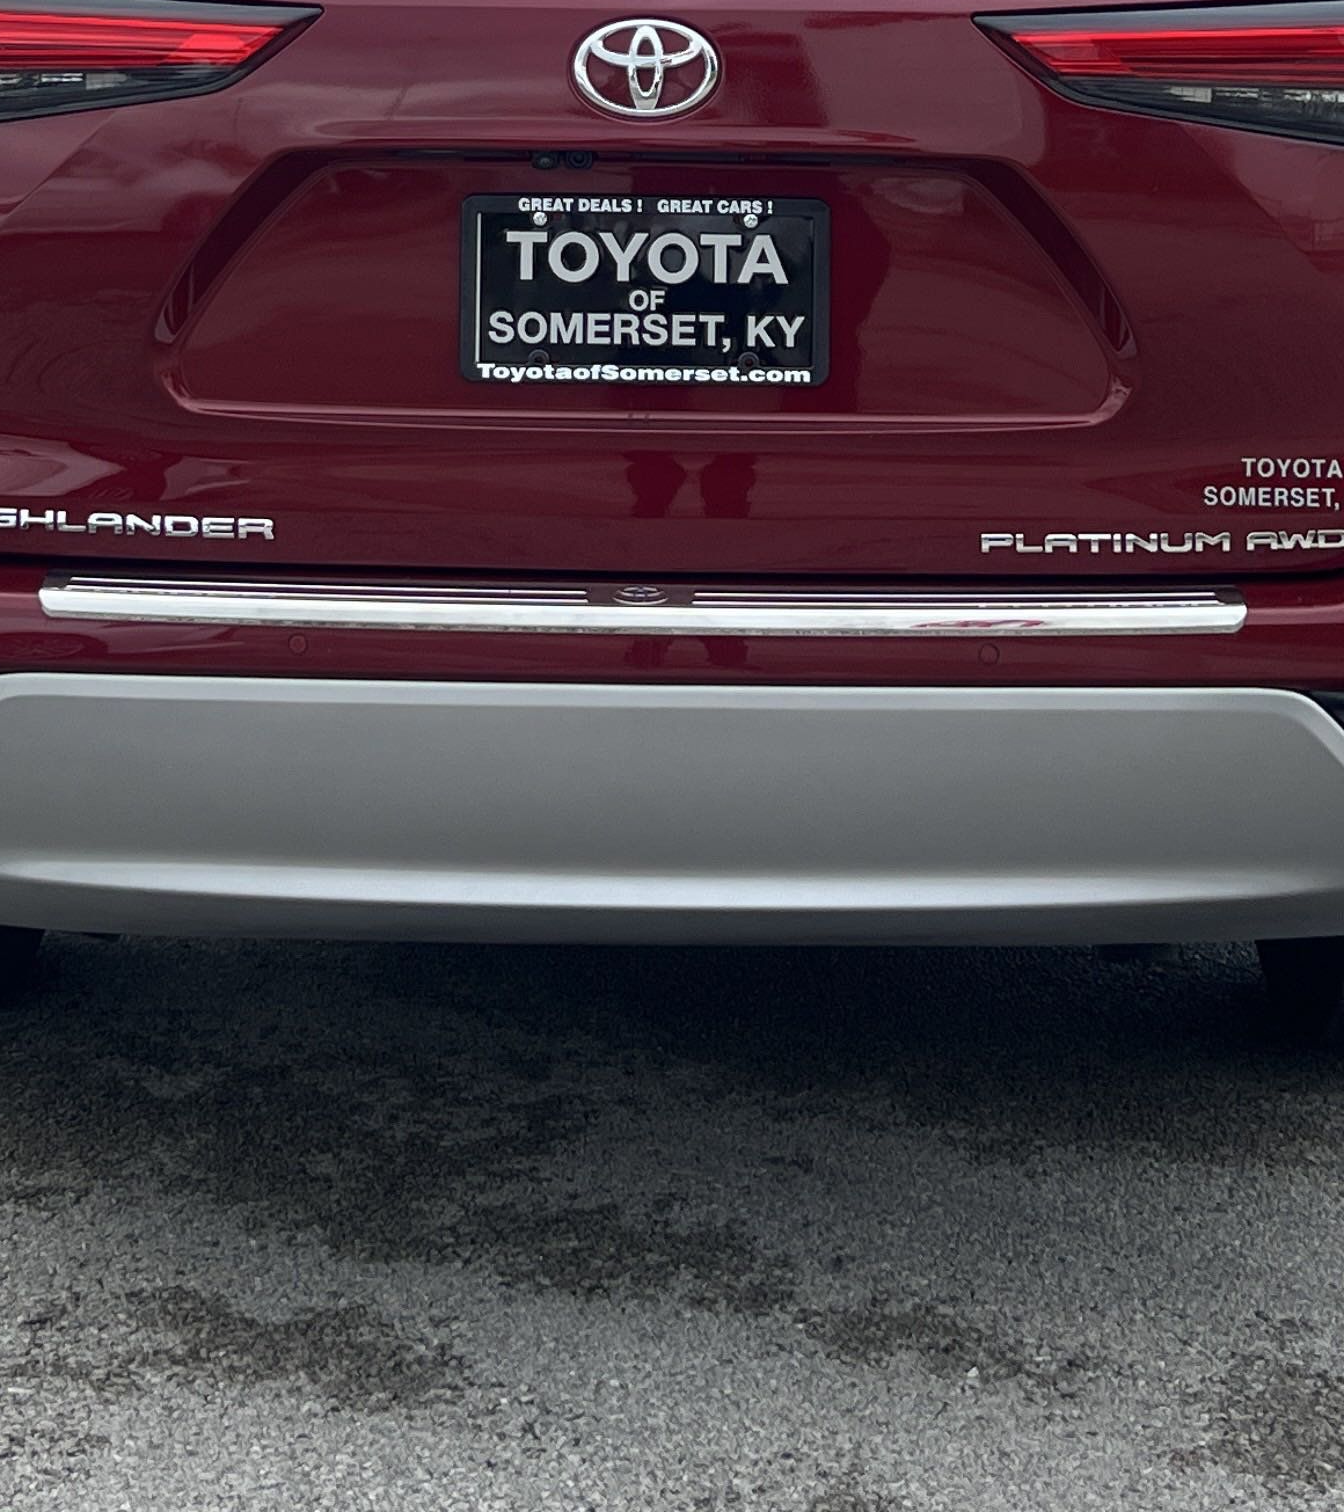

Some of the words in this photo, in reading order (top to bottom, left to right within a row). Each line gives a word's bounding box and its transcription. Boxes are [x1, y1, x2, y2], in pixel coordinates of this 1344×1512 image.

[518, 198, 574, 213] GREAT
[578, 199, 633, 214] DEALS
[657, 200, 713, 214] GREAT
[717, 200, 763, 215] CARS
[506, 231, 789, 285] TOYOTA
[628, 289, 666, 312] OF
[488, 311, 732, 353] SOMERSET,
[746, 315, 805, 348] KY
[476, 362, 812, 384] ToyotaofSomerset.com
[1241, 458, 1344, 479] TOYOTA
[1203, 486, 1341, 510] SOMERSET,
[980, 531, 1232, 554] PLATINUM
